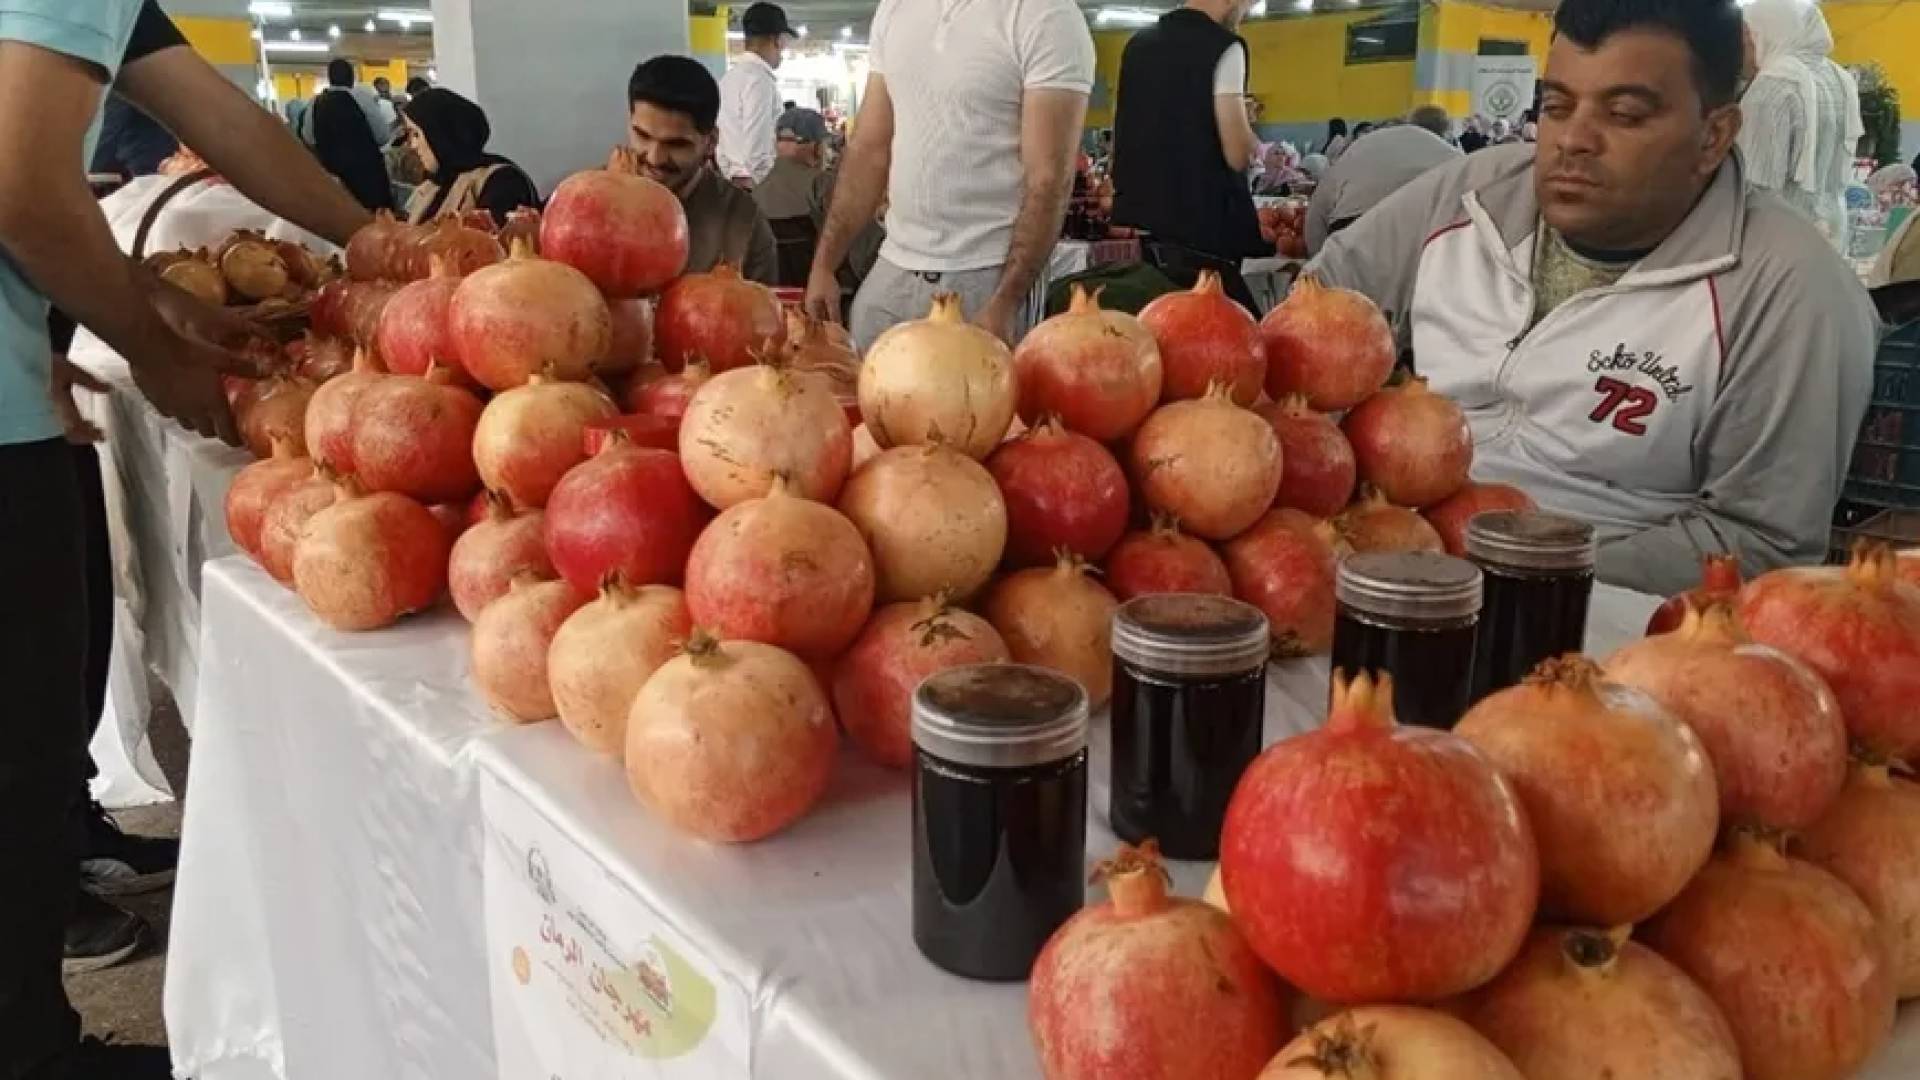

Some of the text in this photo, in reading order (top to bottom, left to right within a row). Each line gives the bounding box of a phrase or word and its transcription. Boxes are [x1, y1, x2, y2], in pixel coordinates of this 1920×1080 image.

[1588, 376, 1658, 436] 72
[540, 913, 583, 965] الرمان
[589, 961, 652, 1036] مهرجان
